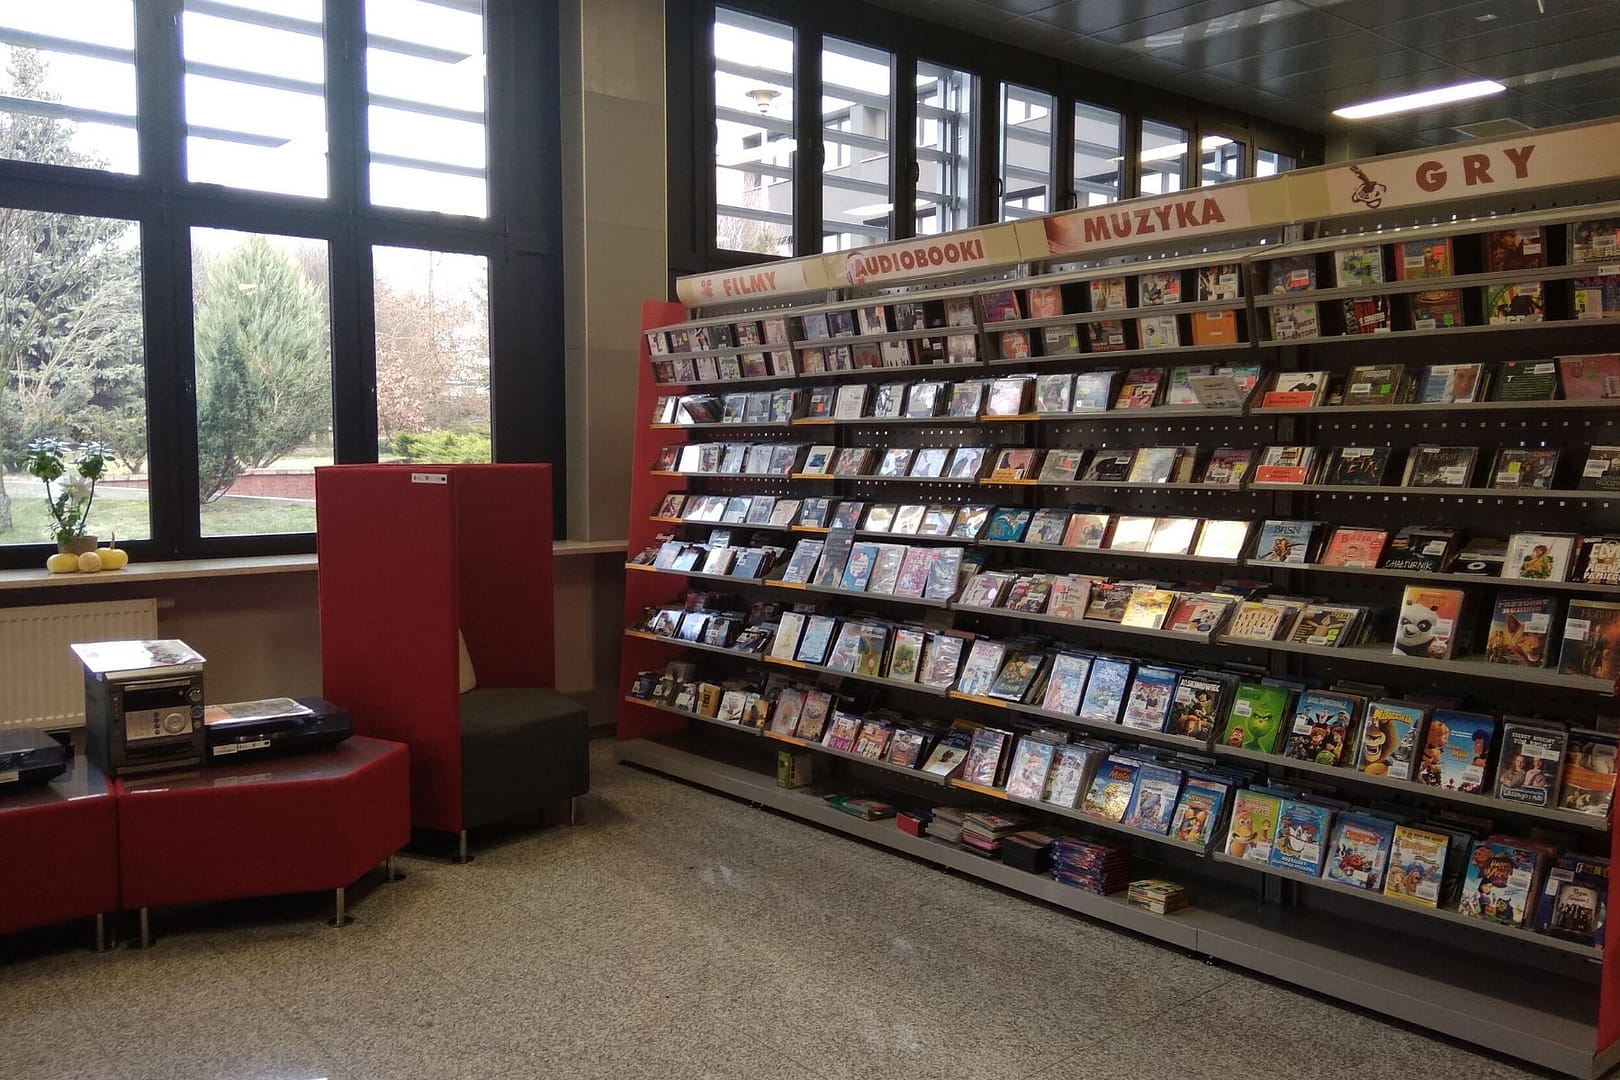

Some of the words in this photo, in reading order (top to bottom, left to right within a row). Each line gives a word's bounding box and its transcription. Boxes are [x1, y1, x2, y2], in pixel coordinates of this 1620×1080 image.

[1415, 144, 1536, 193] GRY
[1083, 197, 1226, 243] MUZYKA
[855, 238, 985, 278] AUDIOBOOKI
[722, 271, 777, 297] FILMY
